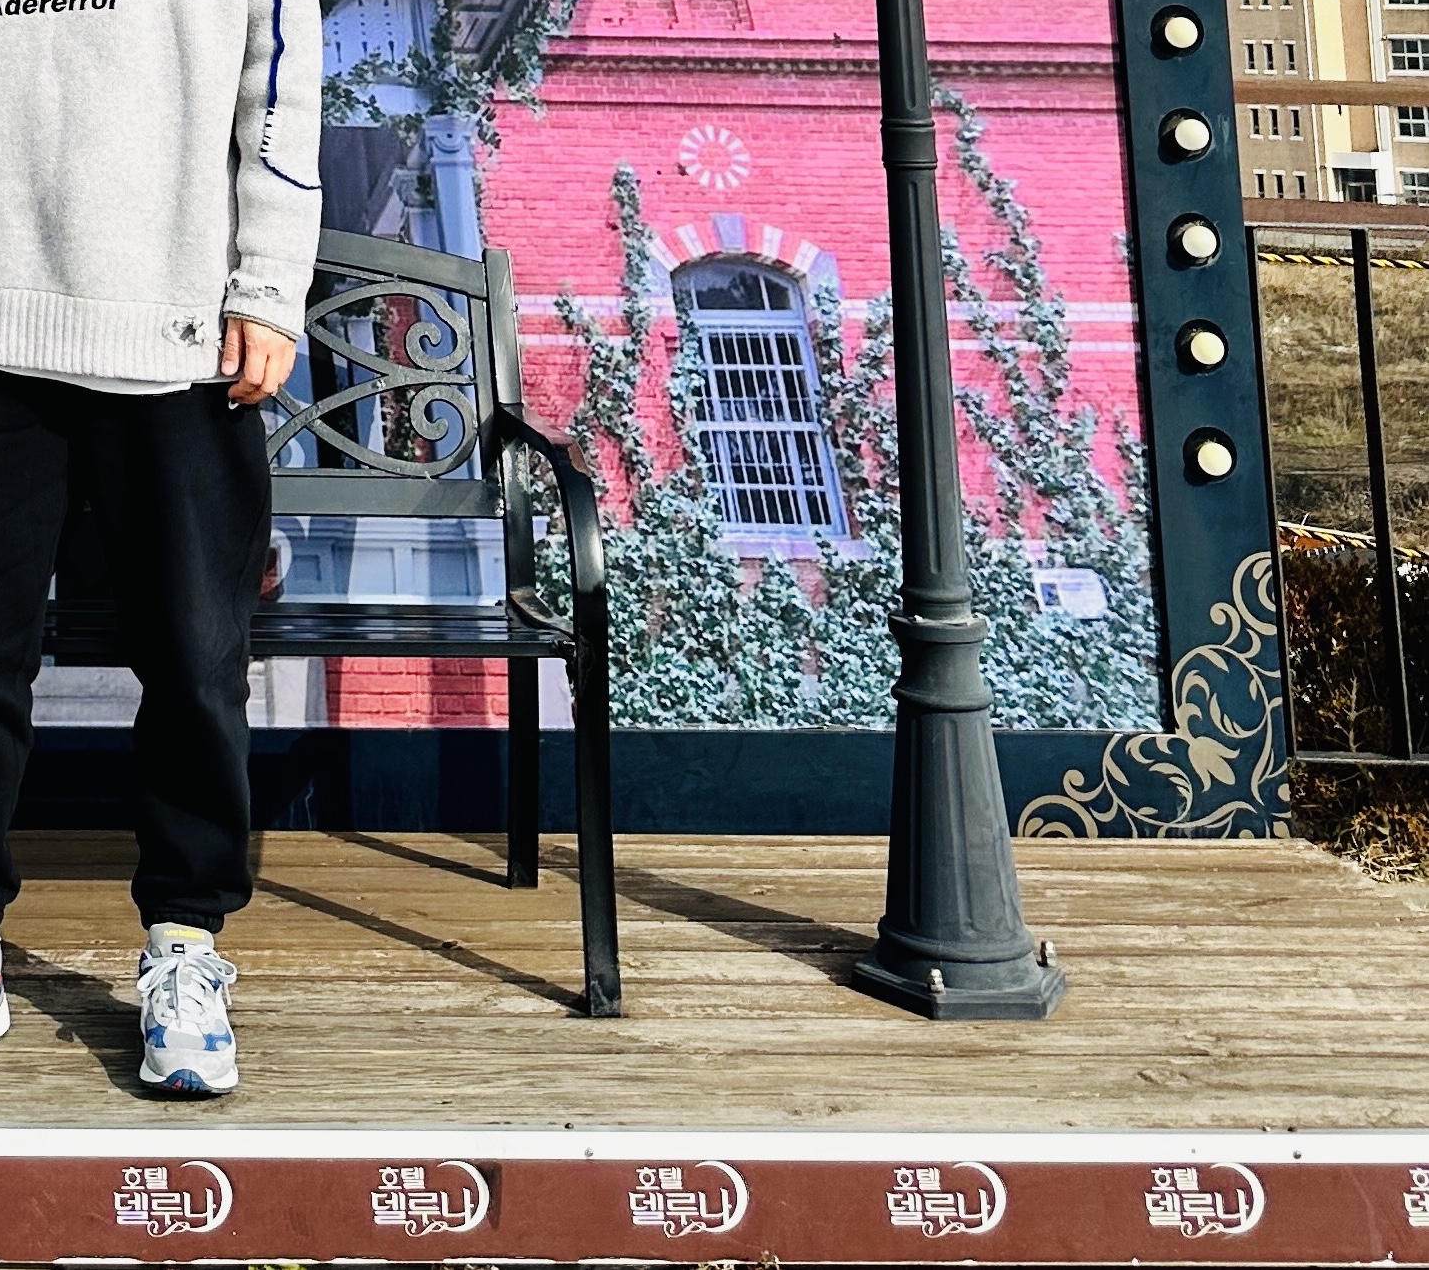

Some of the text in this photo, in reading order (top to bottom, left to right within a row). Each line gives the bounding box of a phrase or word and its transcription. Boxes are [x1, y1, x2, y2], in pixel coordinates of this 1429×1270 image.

[121, 1167, 168, 1190] 호텔
[378, 1167, 426, 1190] 호텔
[636, 1167, 683, 1190] 호텔
[893, 1168, 941, 1191] 호텔
[1151, 1168, 1199, 1191] 호텔
[113, 1191, 217, 1237] 델루나
[370, 1191, 474, 1237] 델루나
[628, 1191, 732, 1237] 델루나
[885, 1192, 989, 1238] 델루나
[1144, 1192, 1248, 1238] 델루나
